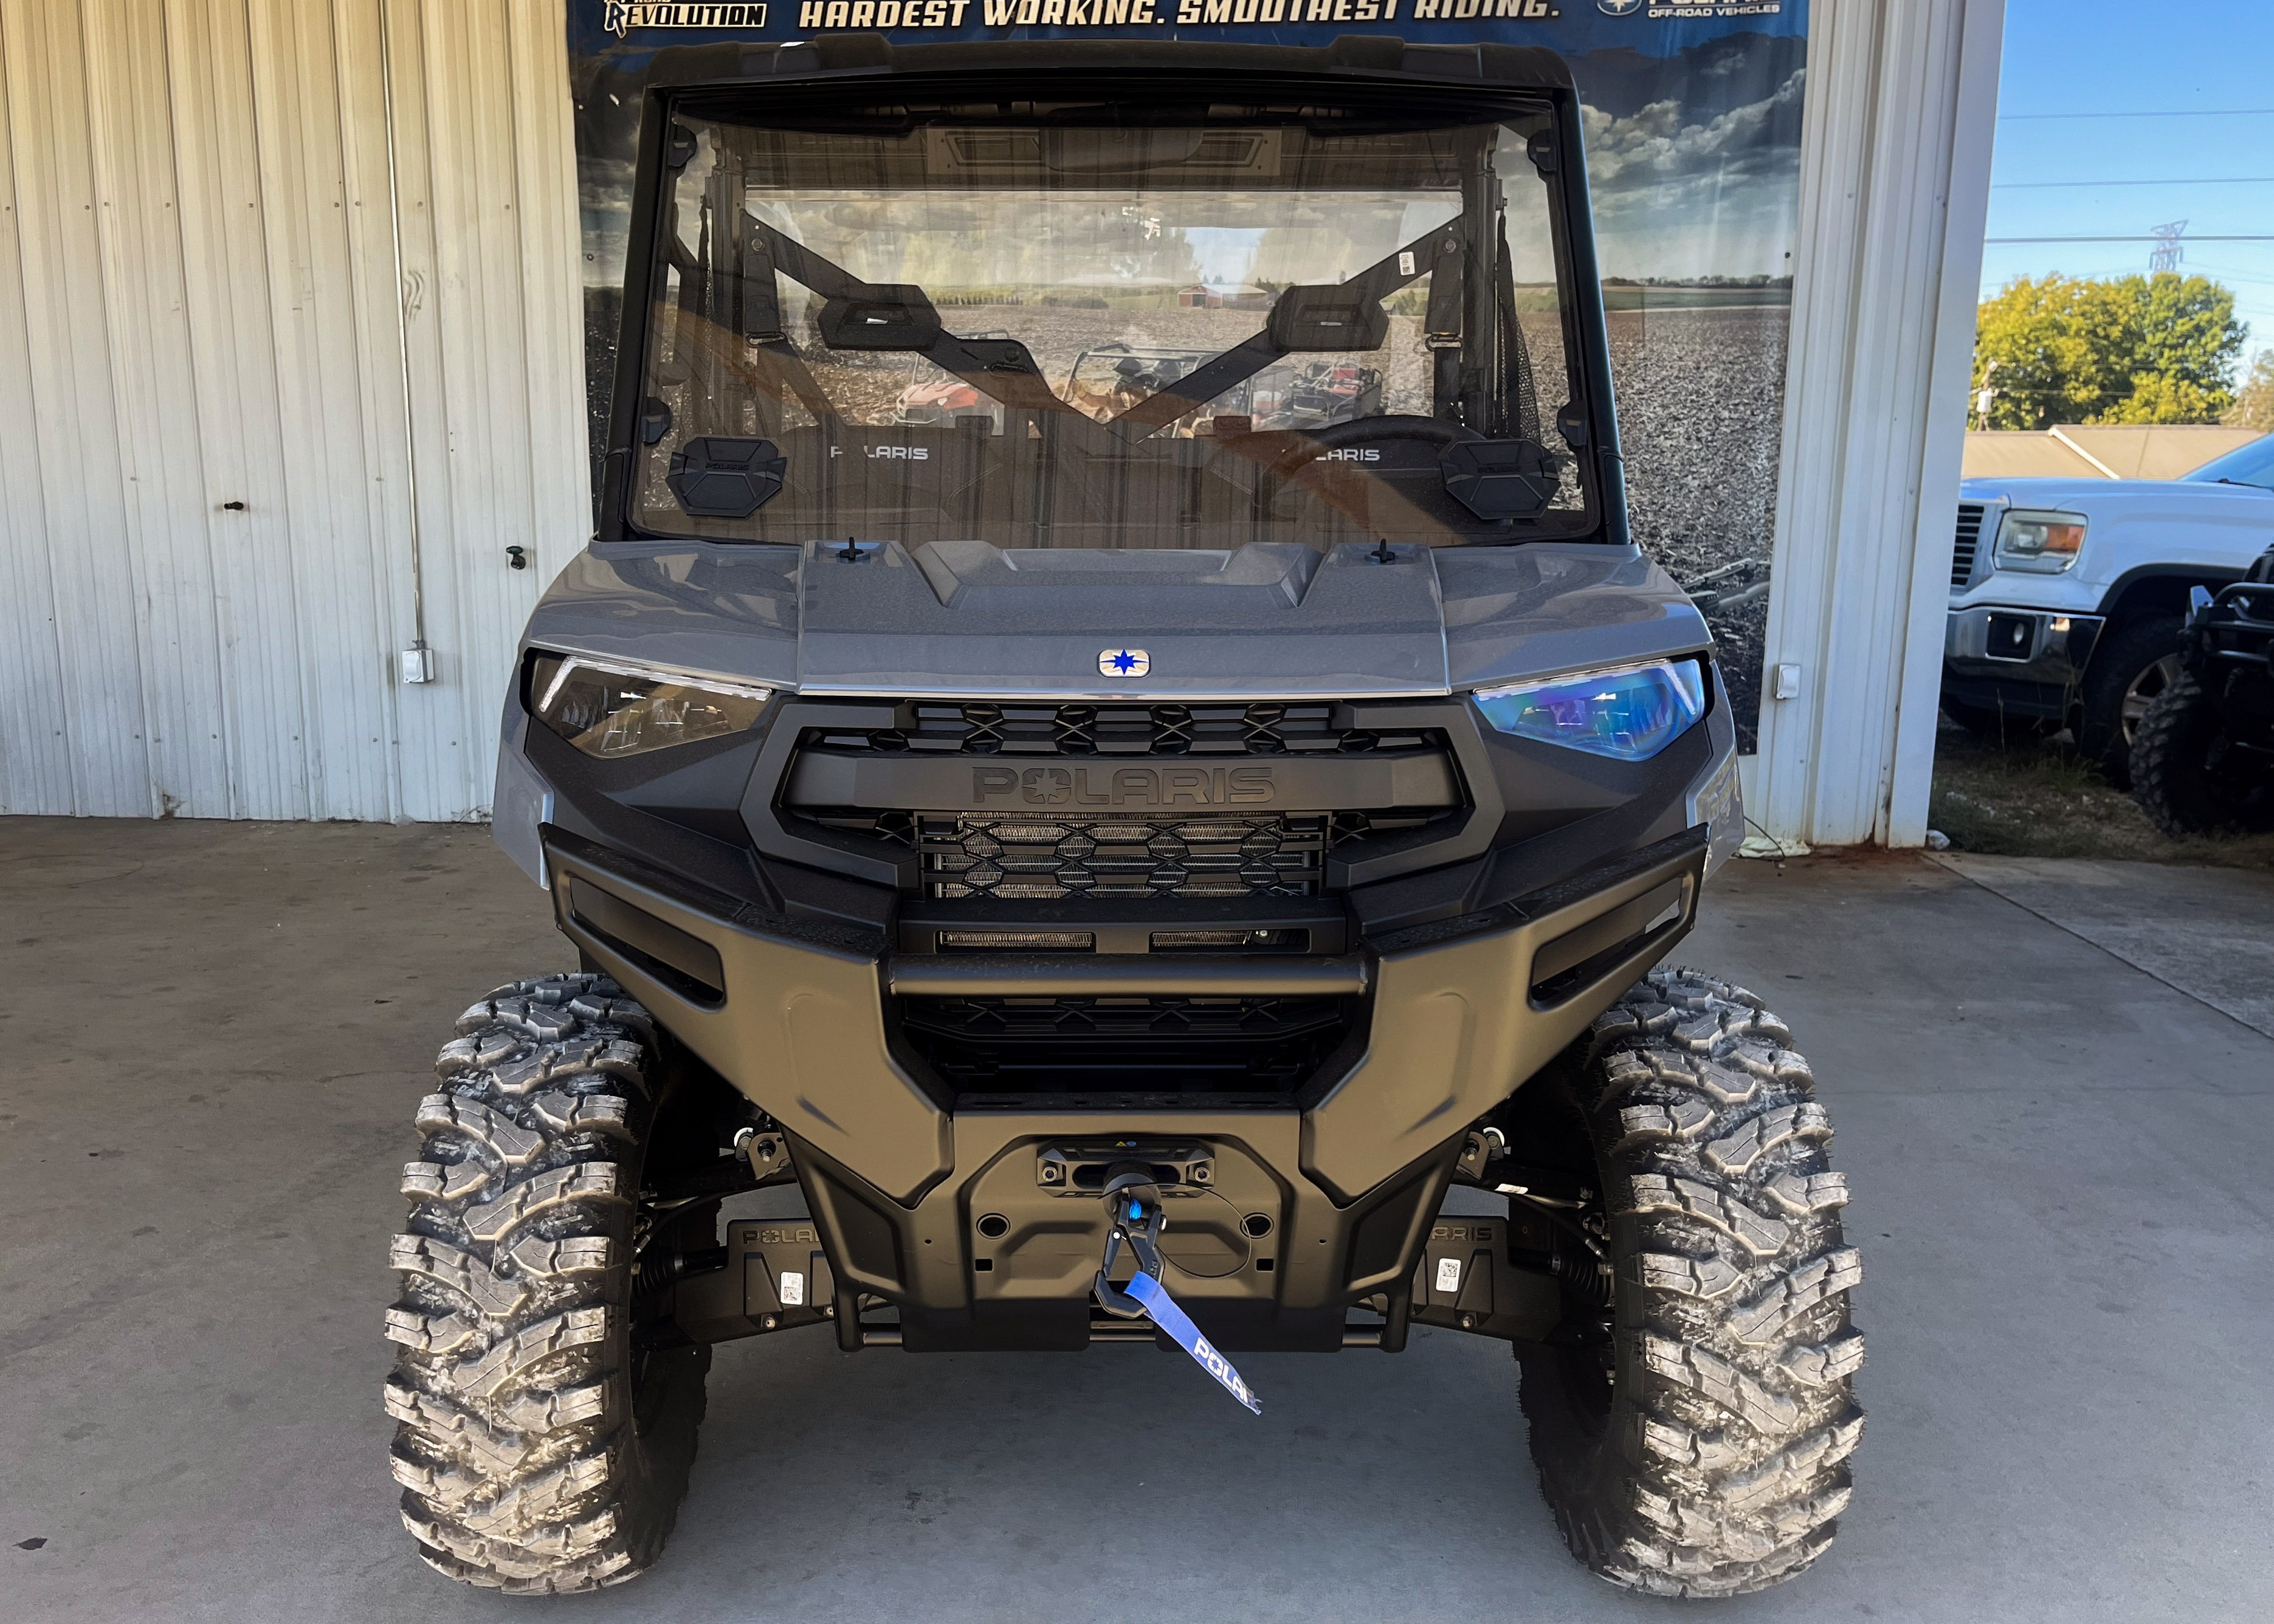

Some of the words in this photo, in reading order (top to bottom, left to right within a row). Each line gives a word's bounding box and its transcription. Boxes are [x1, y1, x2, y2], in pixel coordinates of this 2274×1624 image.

[605, 2, 767, 38] REVOLUTION
[799, 0, 971, 27] HARDEST
[984, 0, 1164, 26] WORKING.
[1177, 0, 1397, 23] SMOOTHEST
[1413, 0, 1560, 18] RIDING.
[1648, 9, 1713, 18] OFF-ROAD
[1716, 4, 1780, 16] VEHICLES
[830, 446, 929, 460] PLARIS
[972, 766, 1275, 805] POLARIS
